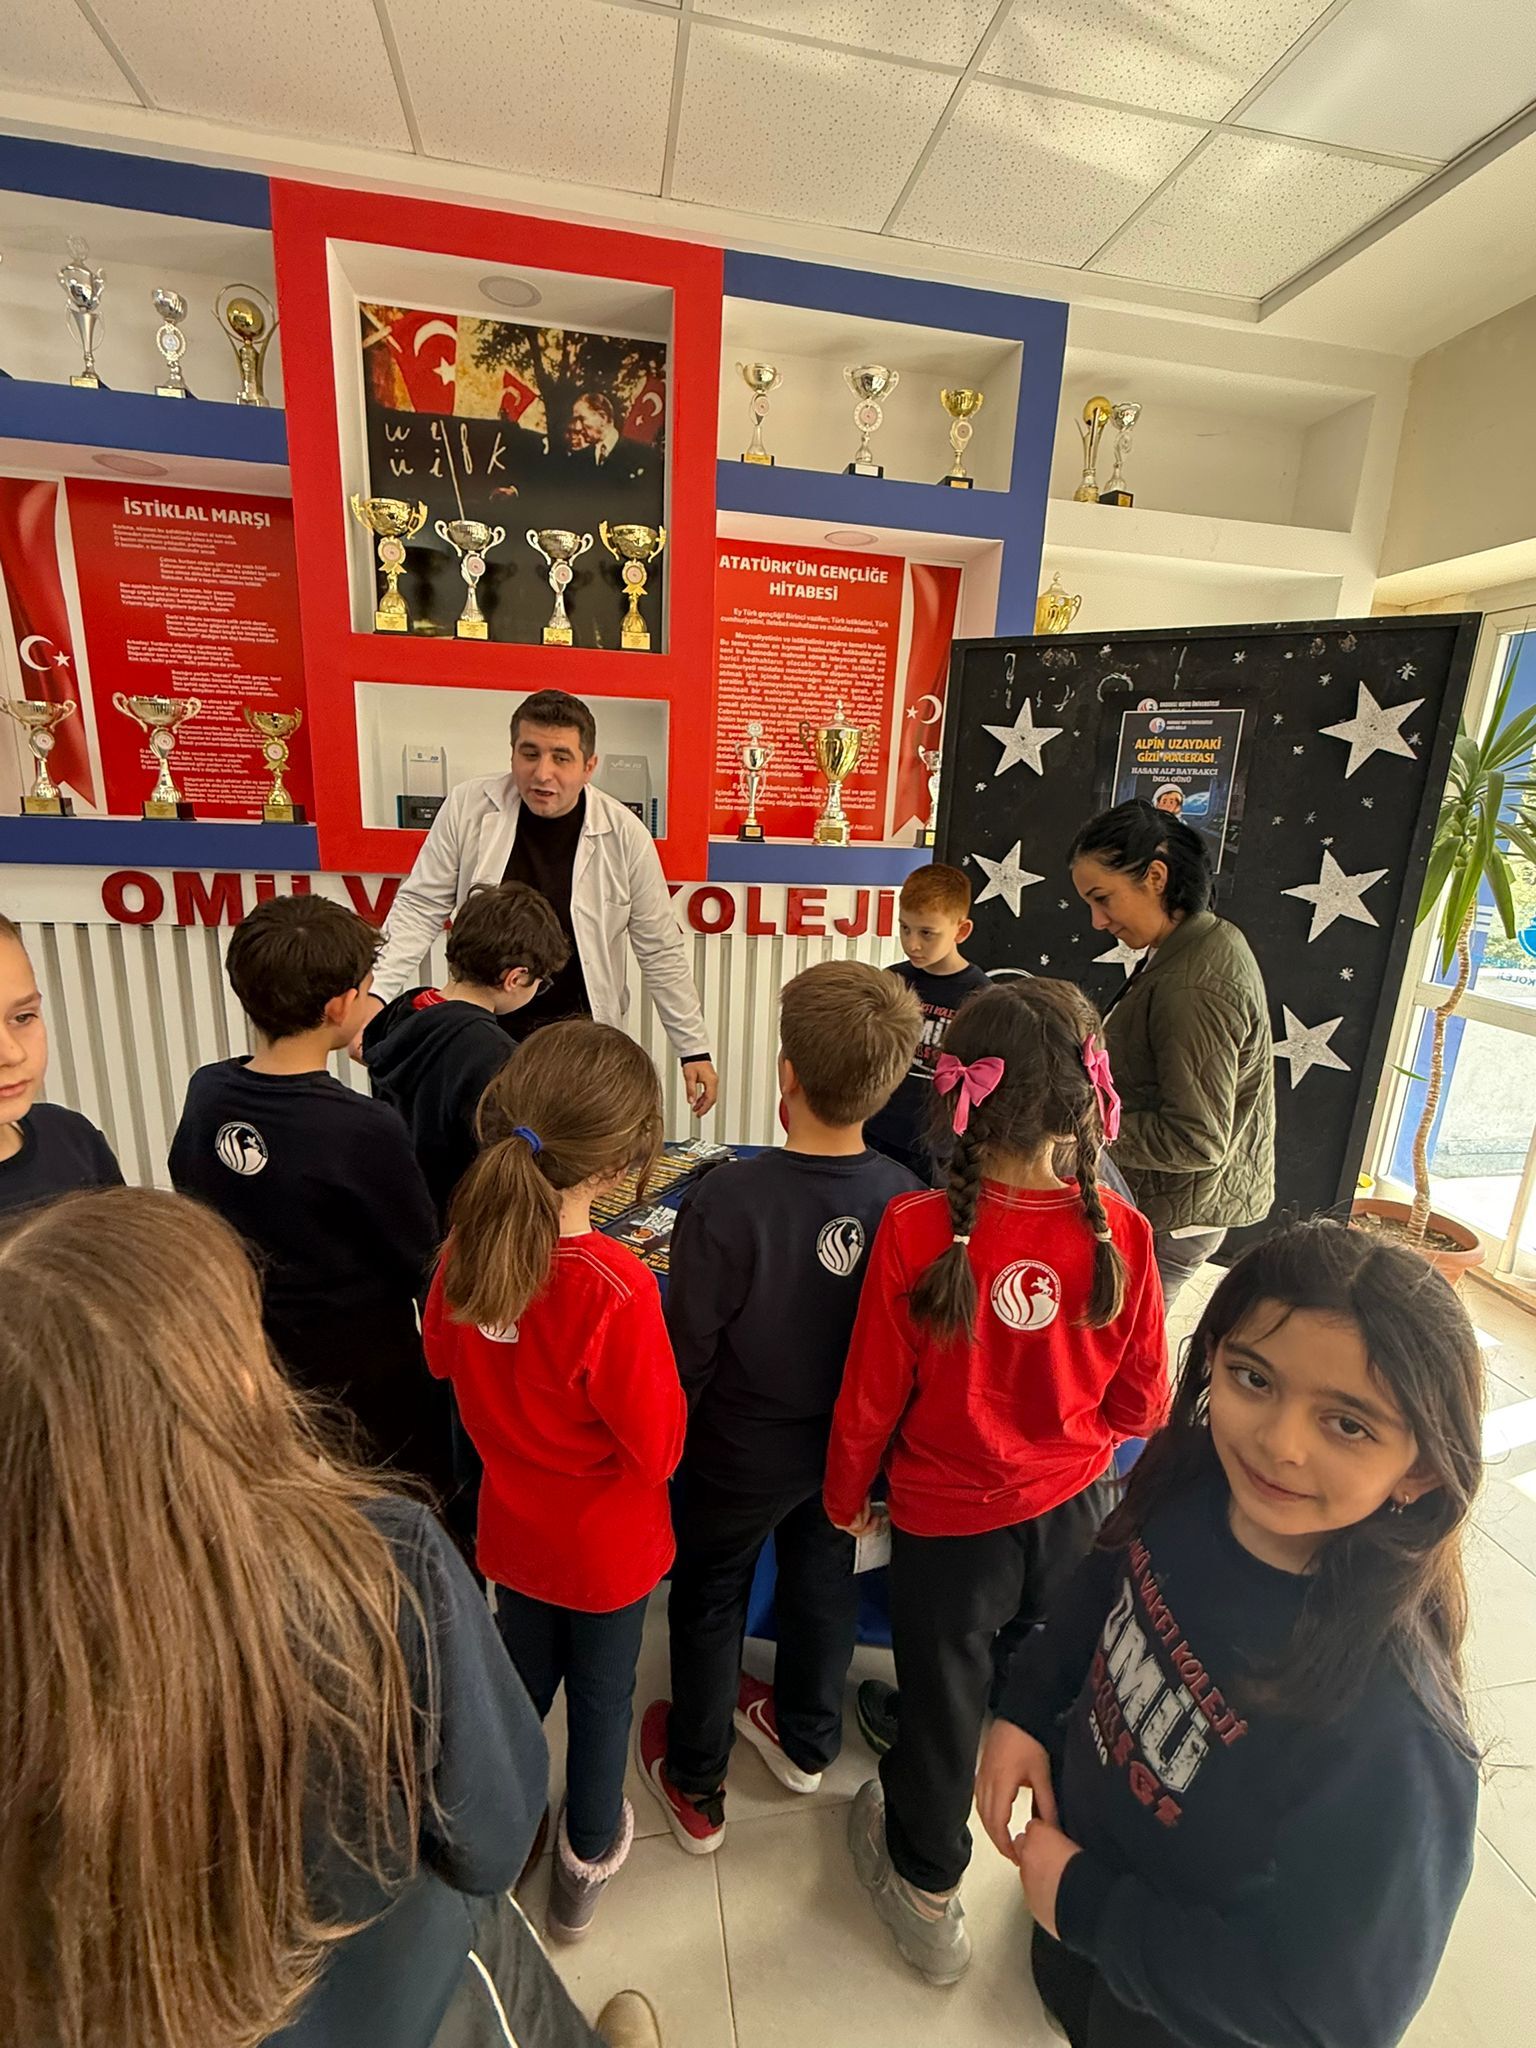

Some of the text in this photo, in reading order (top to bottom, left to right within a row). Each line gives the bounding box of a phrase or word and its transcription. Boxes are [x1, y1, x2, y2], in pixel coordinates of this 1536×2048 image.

[123, 496, 271, 529] İSTİKLAL MARŞI
[819, 564, 889, 584] GENÇLİĞE
[769, 581, 838, 601] HİTABESİ
[1168, 736, 1222, 750] UZAYDAKİ
[668, 884, 895, 937] OLEJİ
[1170, 1640, 1249, 1746] KOLEJİ
